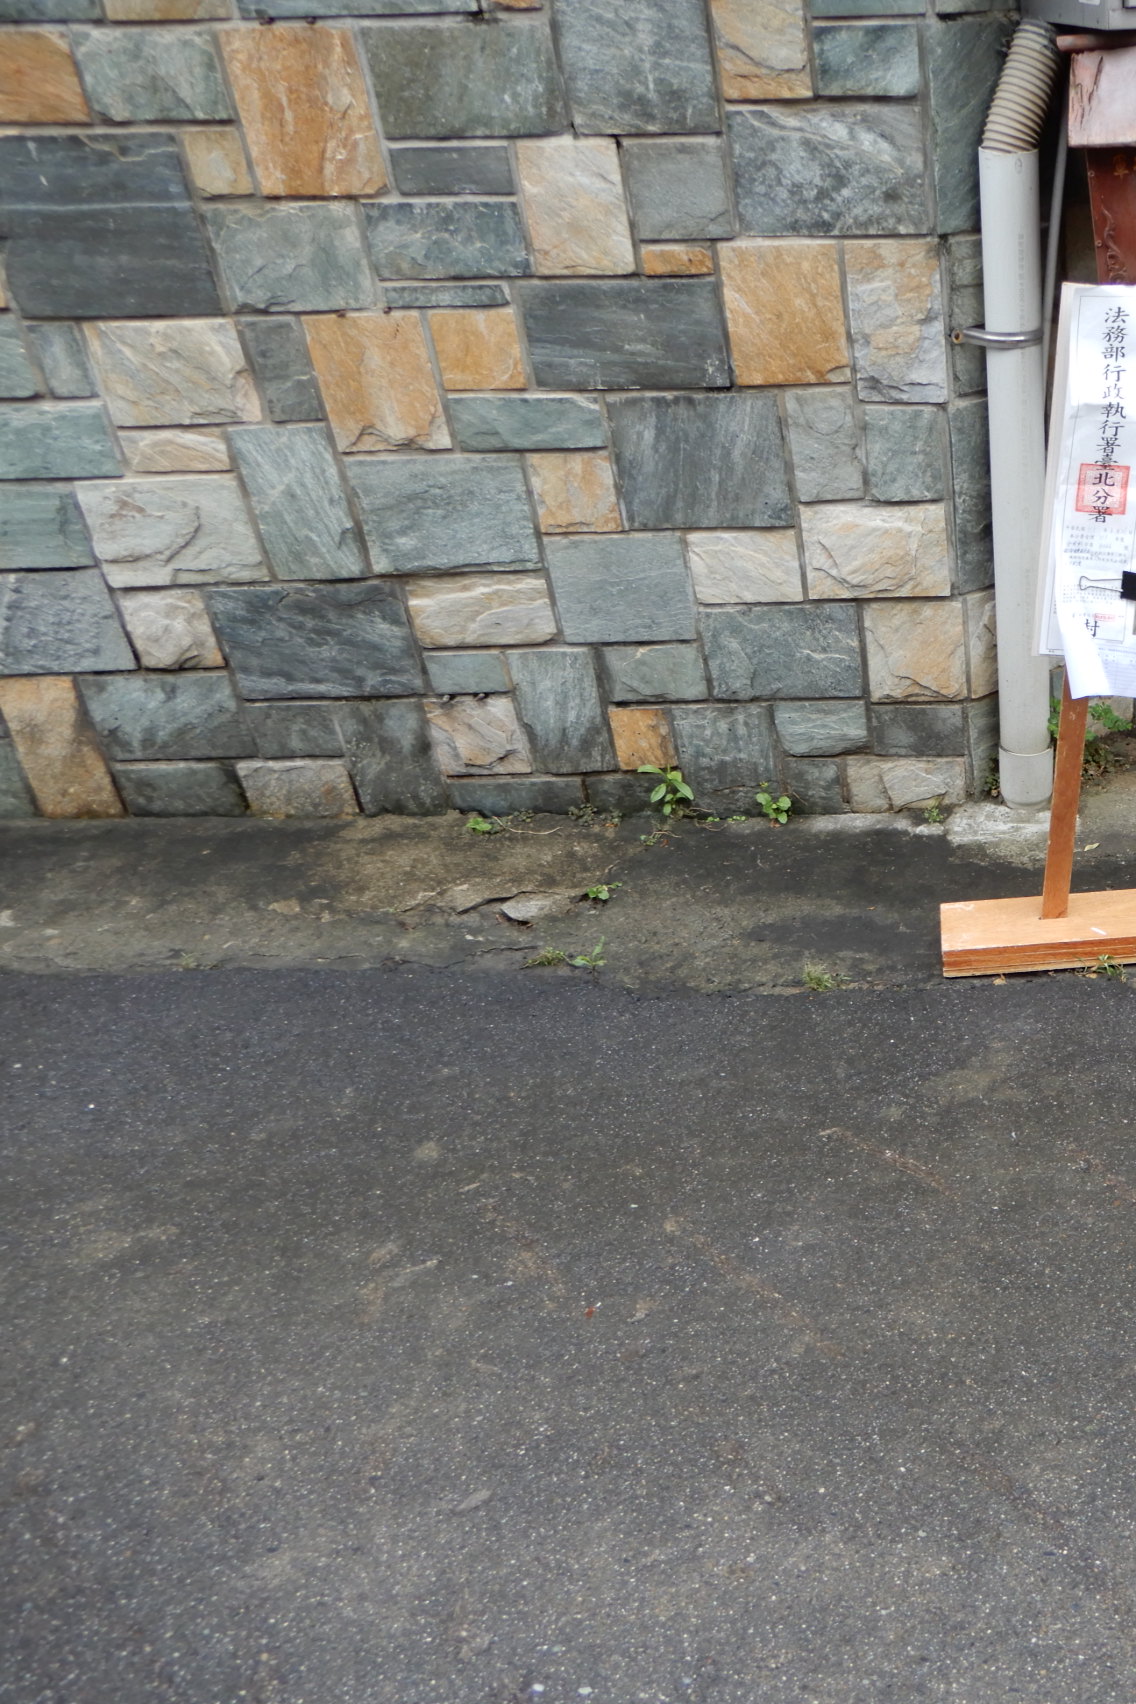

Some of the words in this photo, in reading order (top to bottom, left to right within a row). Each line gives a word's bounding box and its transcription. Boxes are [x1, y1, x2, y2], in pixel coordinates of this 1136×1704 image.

[1088, 306, 1130, 523] 法務部行政執行署臺北分署
